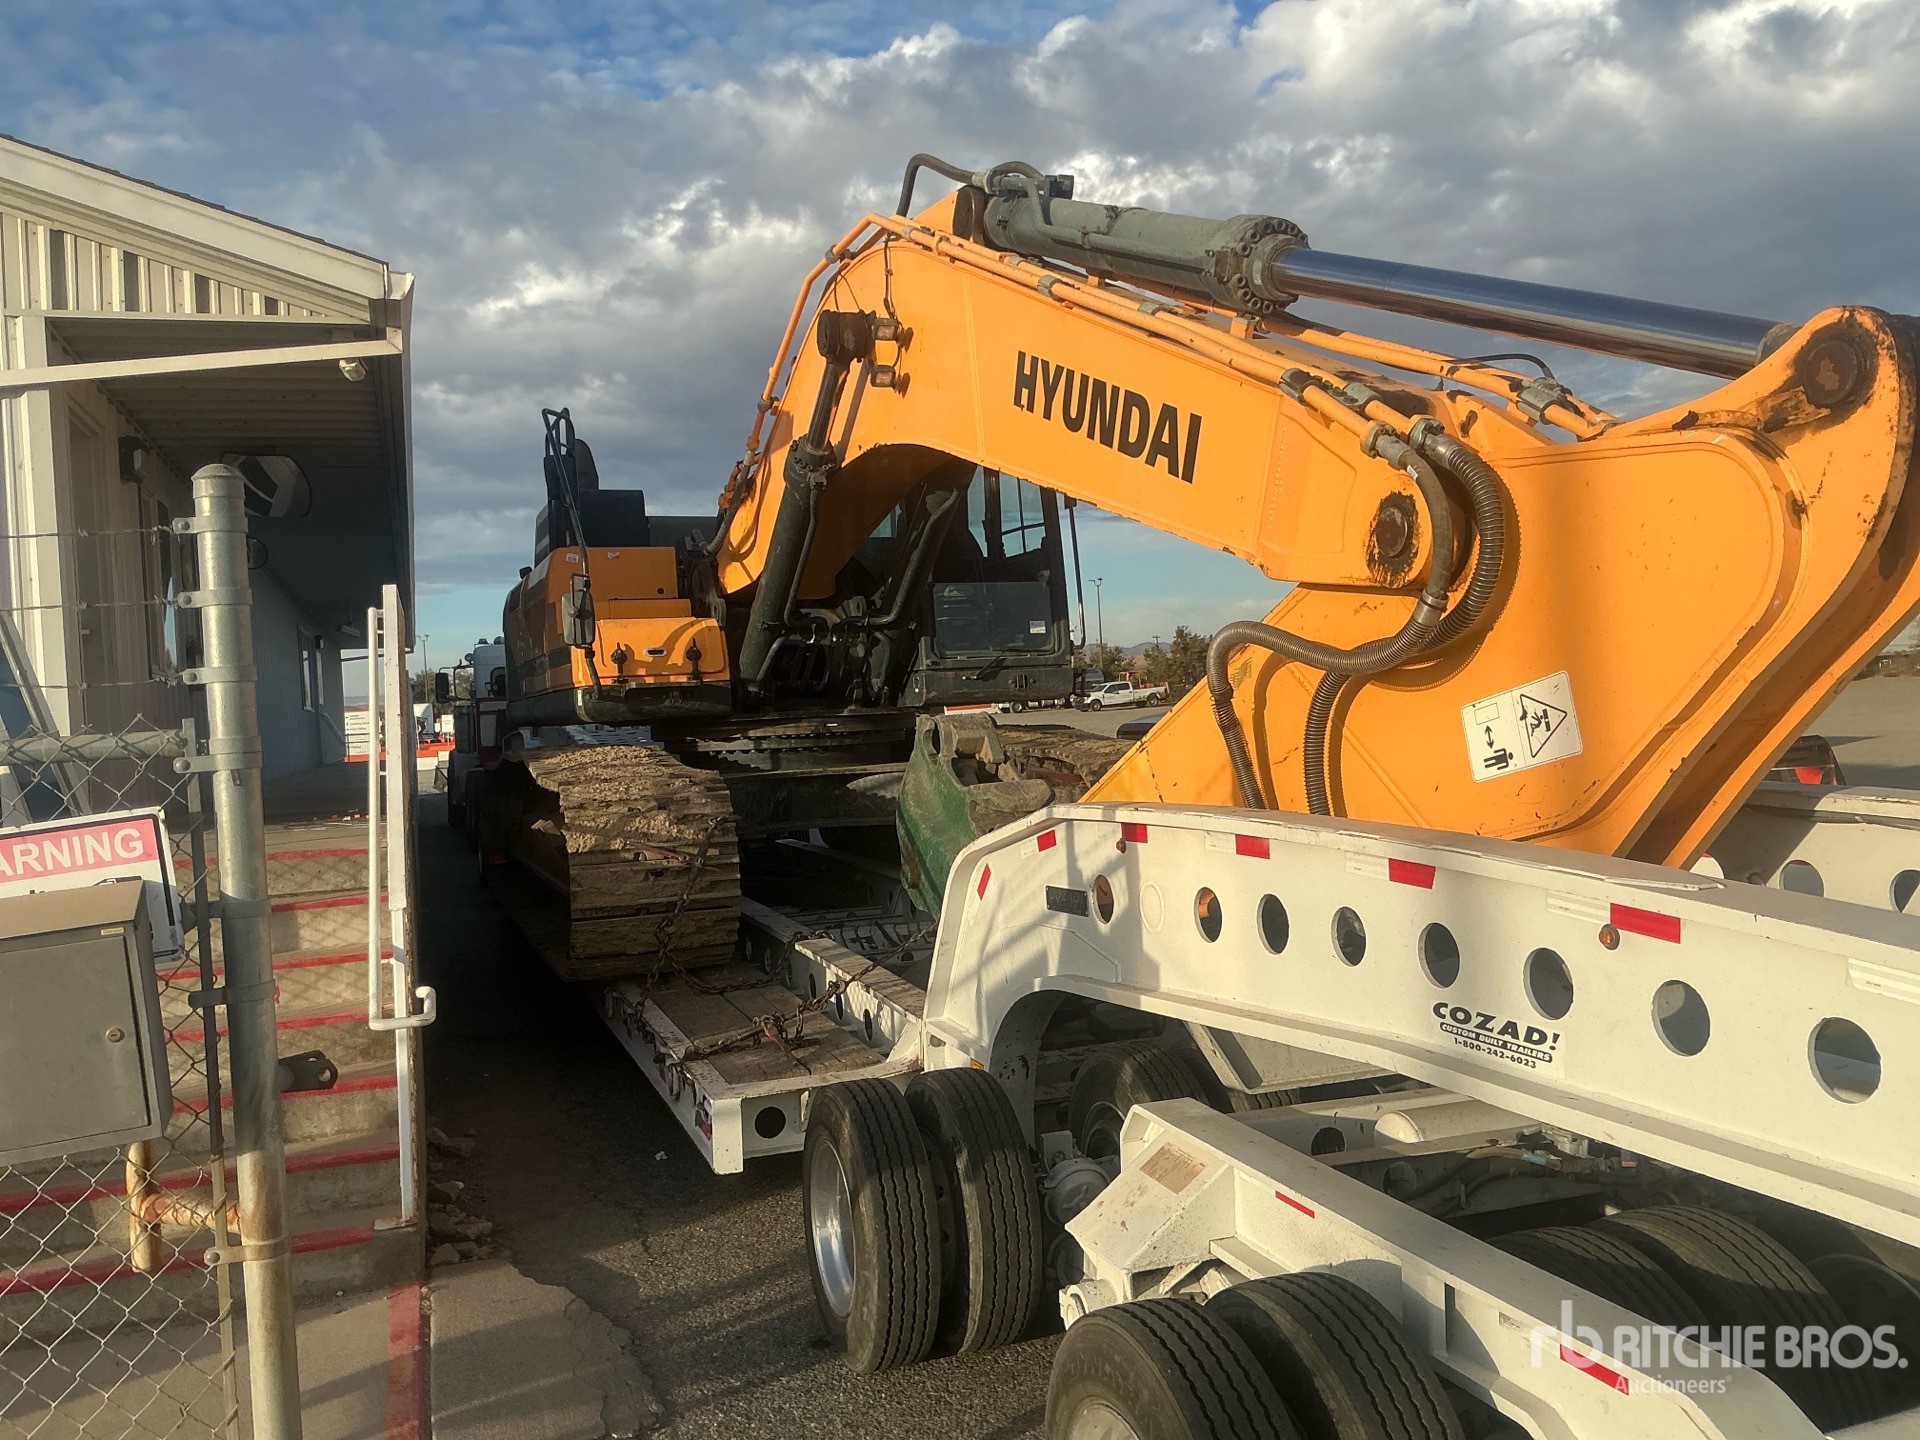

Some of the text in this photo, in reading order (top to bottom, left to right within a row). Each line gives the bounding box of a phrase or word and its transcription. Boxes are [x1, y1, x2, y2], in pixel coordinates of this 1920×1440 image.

[1013, 350, 1202, 484] HYUNDAI
[1432, 1002, 1560, 1051] COZAD!
[1441, 1023, 1551, 1062] CUSTOM BUILT TRAILERS
[1453, 1036, 1537, 1069] 1-800-242-6023
